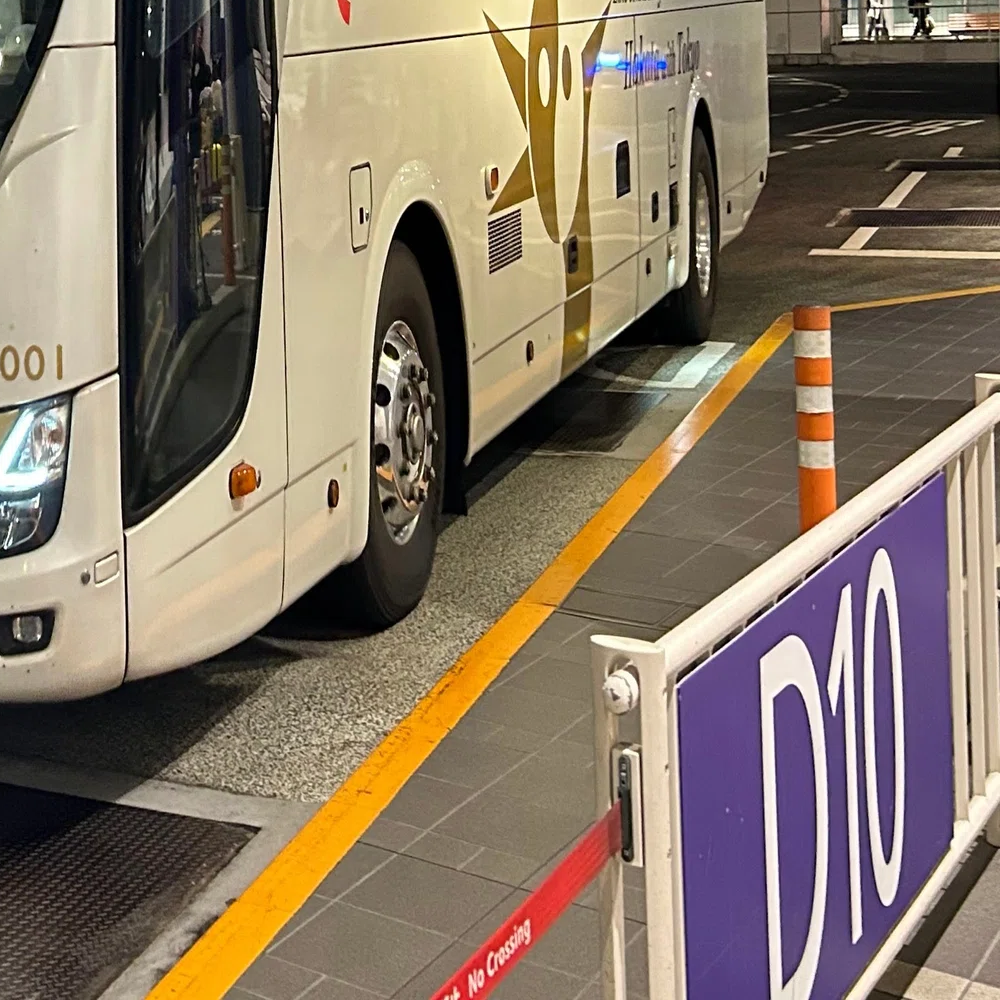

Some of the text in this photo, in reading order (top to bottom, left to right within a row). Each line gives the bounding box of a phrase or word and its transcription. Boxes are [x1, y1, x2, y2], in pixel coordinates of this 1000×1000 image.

[677, 27, 699, 83] Tokyo
[760, 548, 905, 1000] D10
[467, 918, 531, 999] No Crossing
